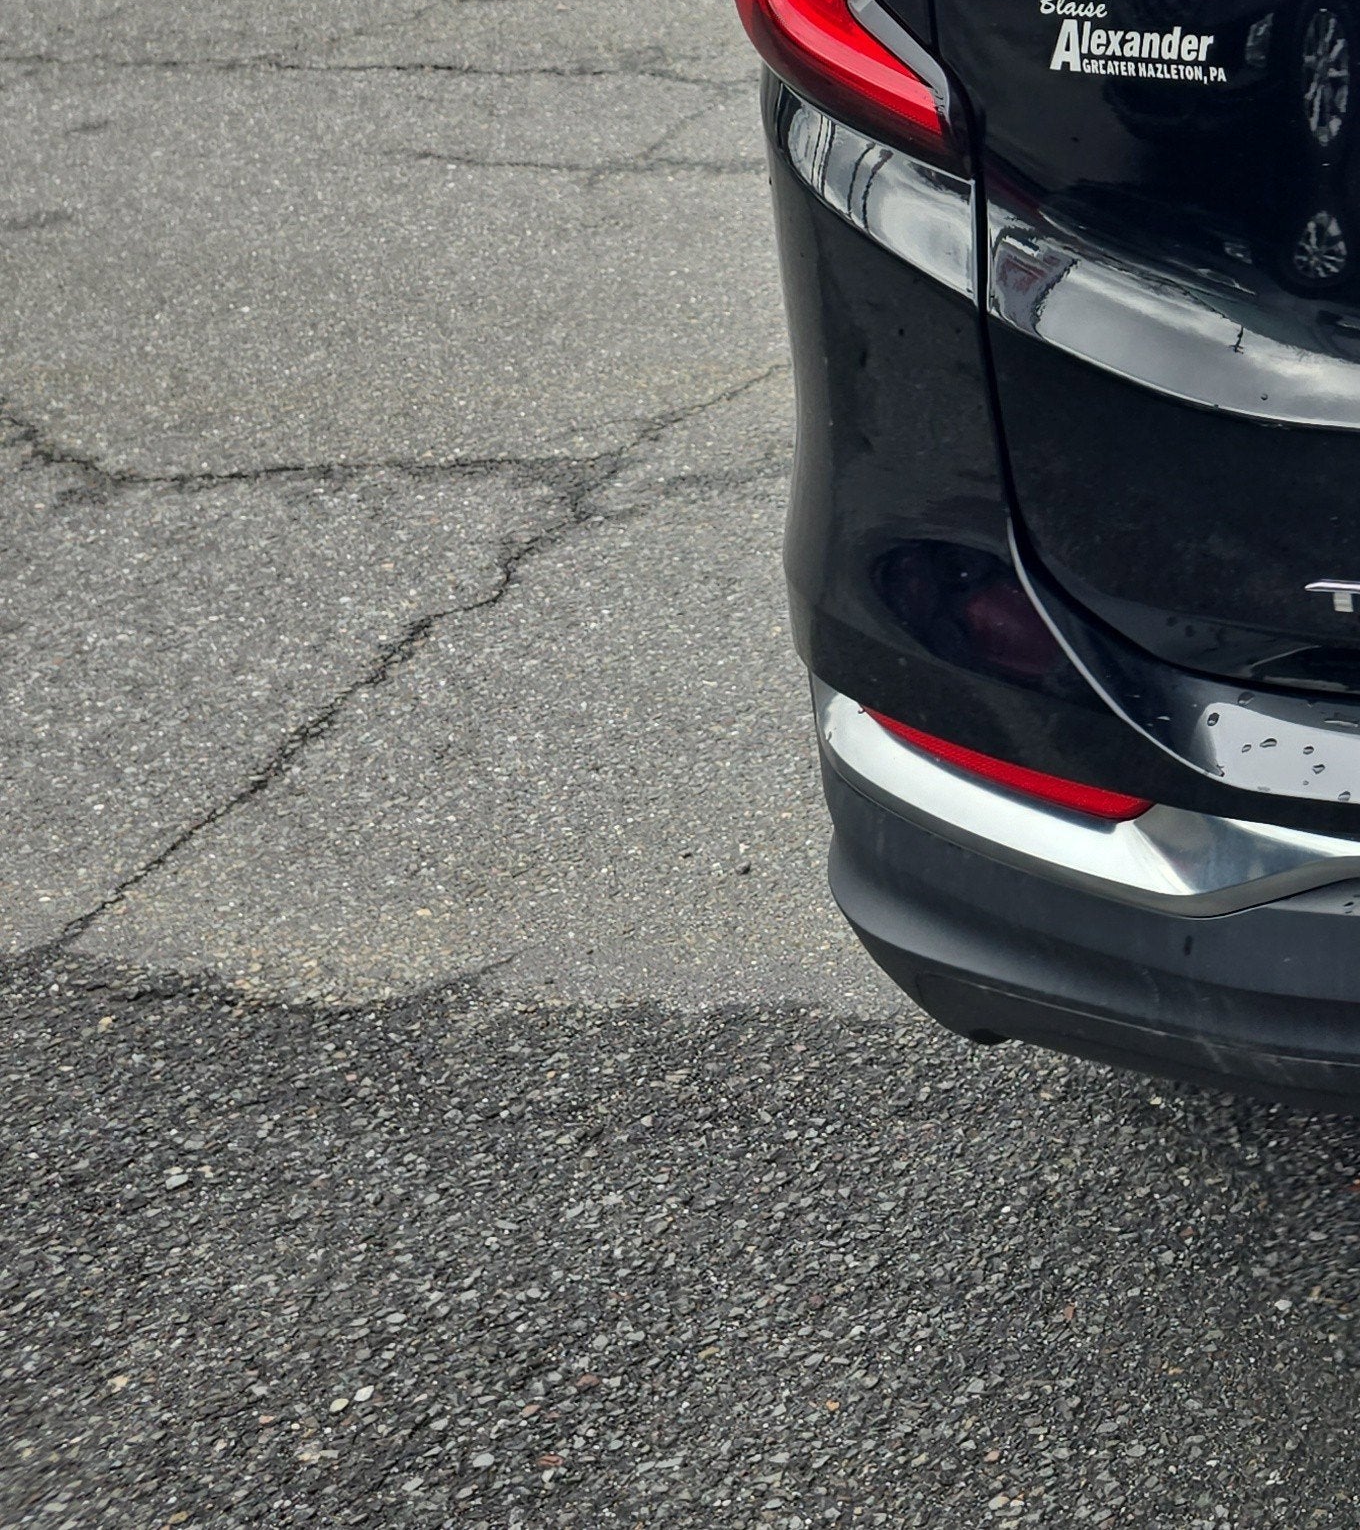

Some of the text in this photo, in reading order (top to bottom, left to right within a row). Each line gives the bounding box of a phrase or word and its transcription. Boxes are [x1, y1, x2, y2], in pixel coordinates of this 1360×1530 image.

[1050, 19, 1214, 72] Alexander
[1082, 58, 1227, 84] GREATER HAZLETON, PA
